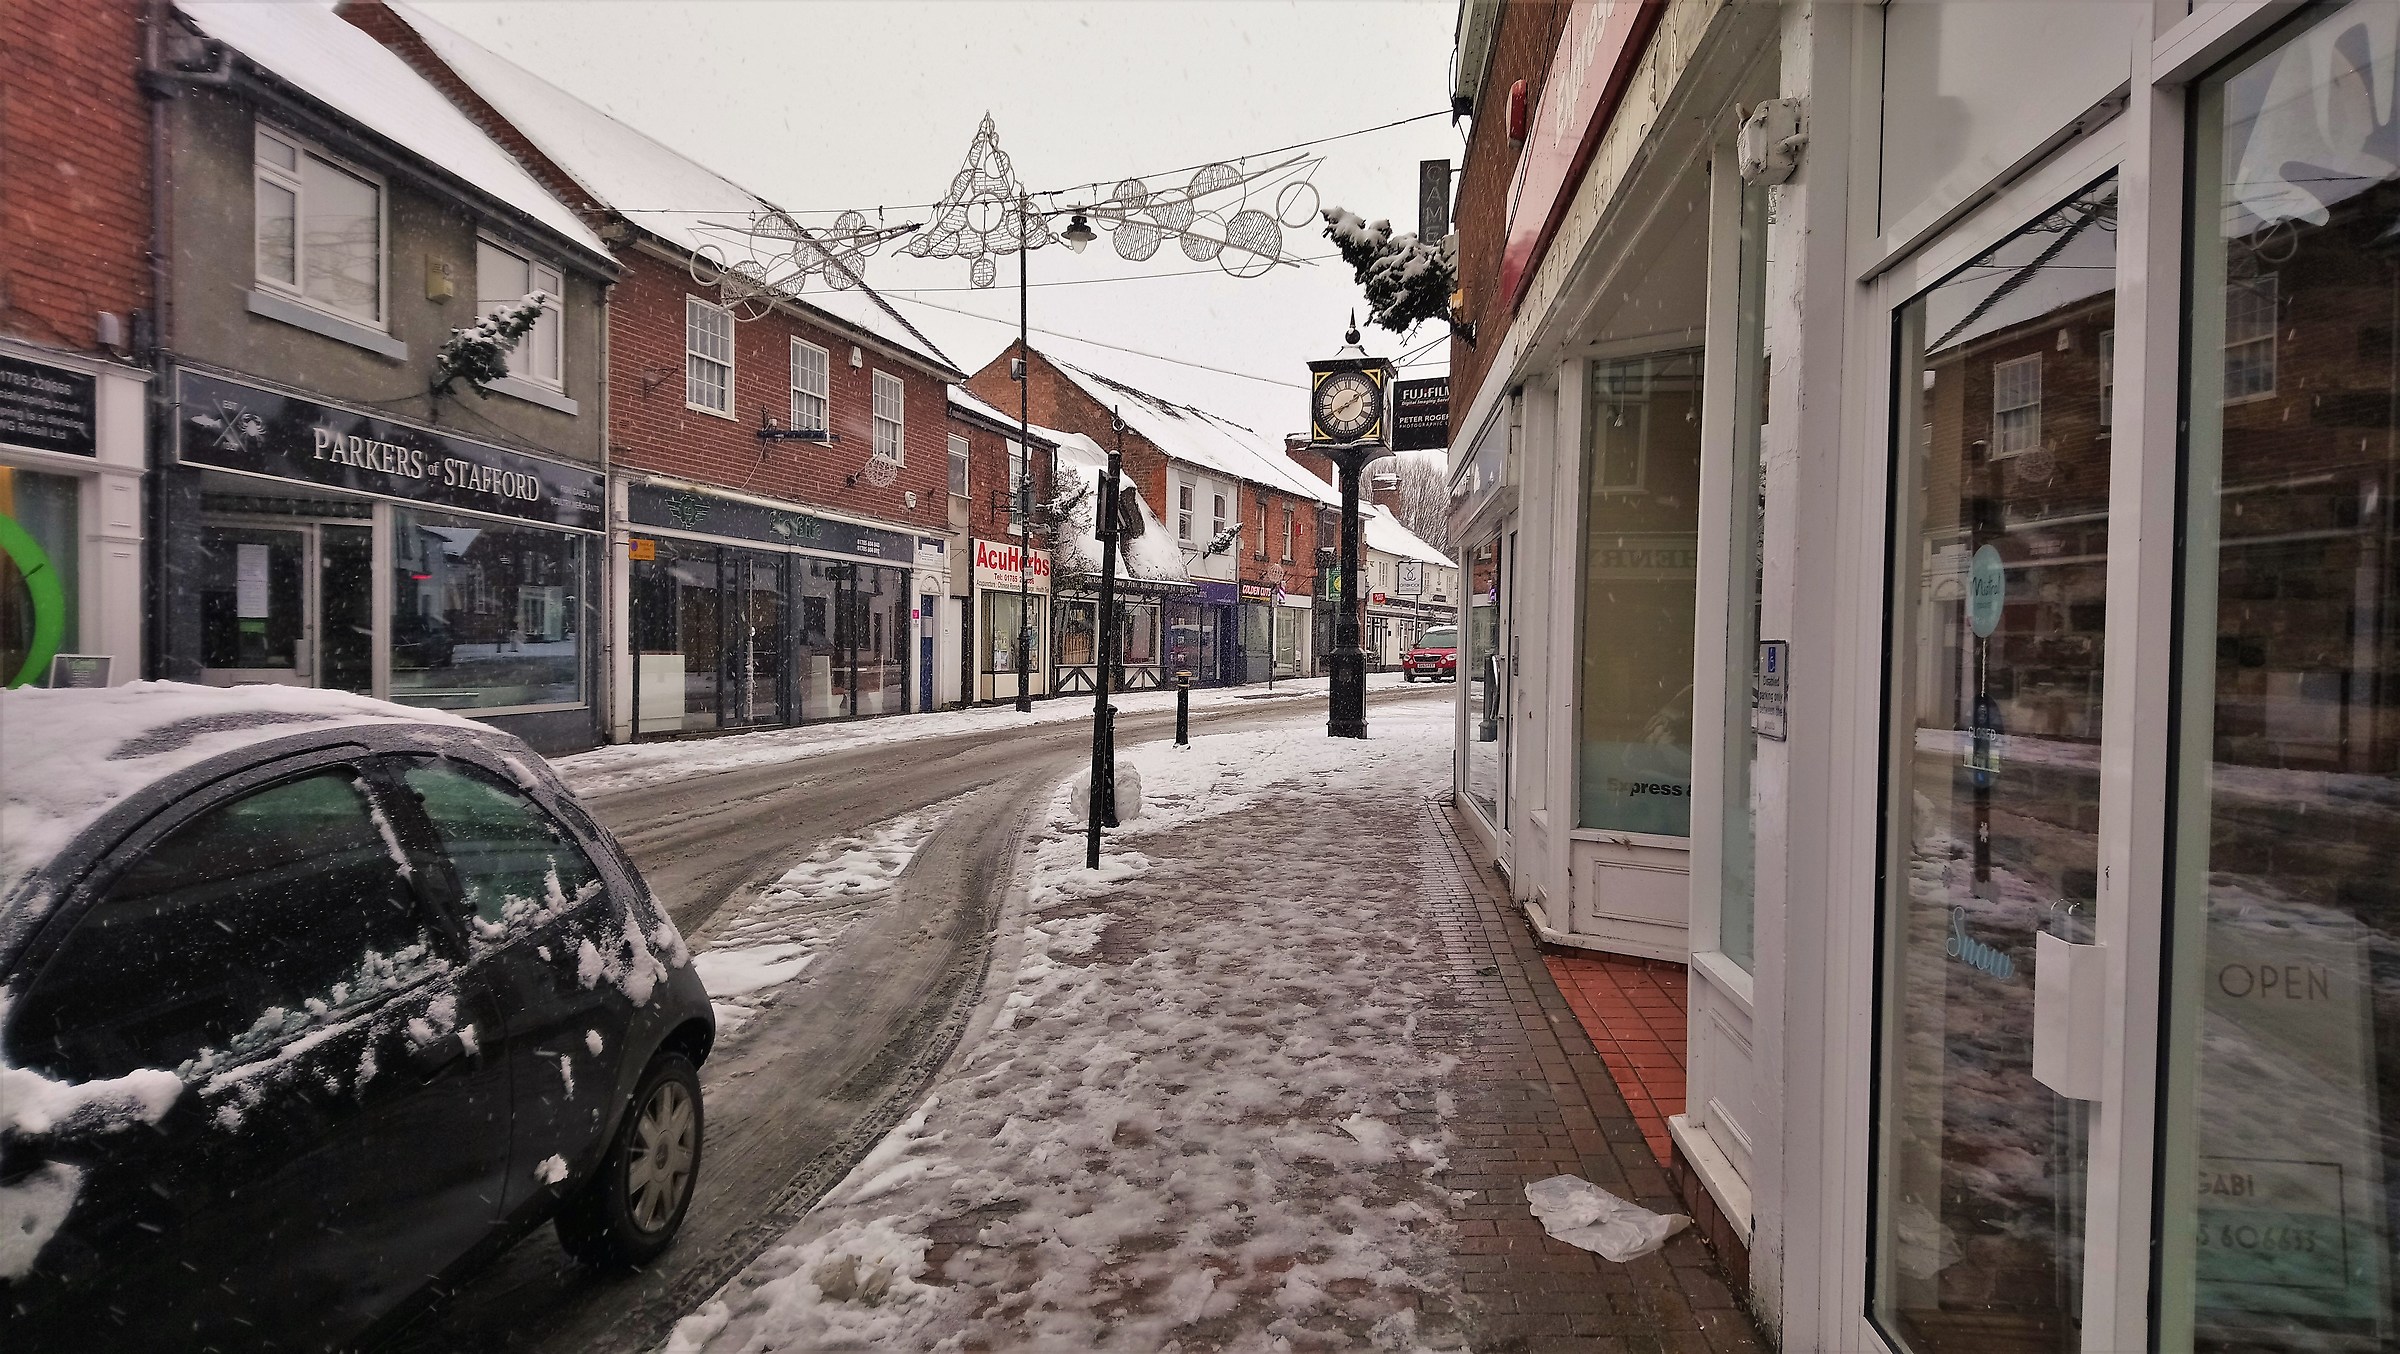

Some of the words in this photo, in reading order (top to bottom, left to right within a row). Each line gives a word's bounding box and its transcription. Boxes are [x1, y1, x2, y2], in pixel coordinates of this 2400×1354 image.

[313, 427, 423, 479] PARKERS
[427, 461, 440, 477] of
[443, 457, 540, 501] STAFFORD
[1242, 584, 1260, 595] GOLDEN
[1968, 726, 1997, 741] CLOSED
[2218, 963, 2329, 1000] OPEN
